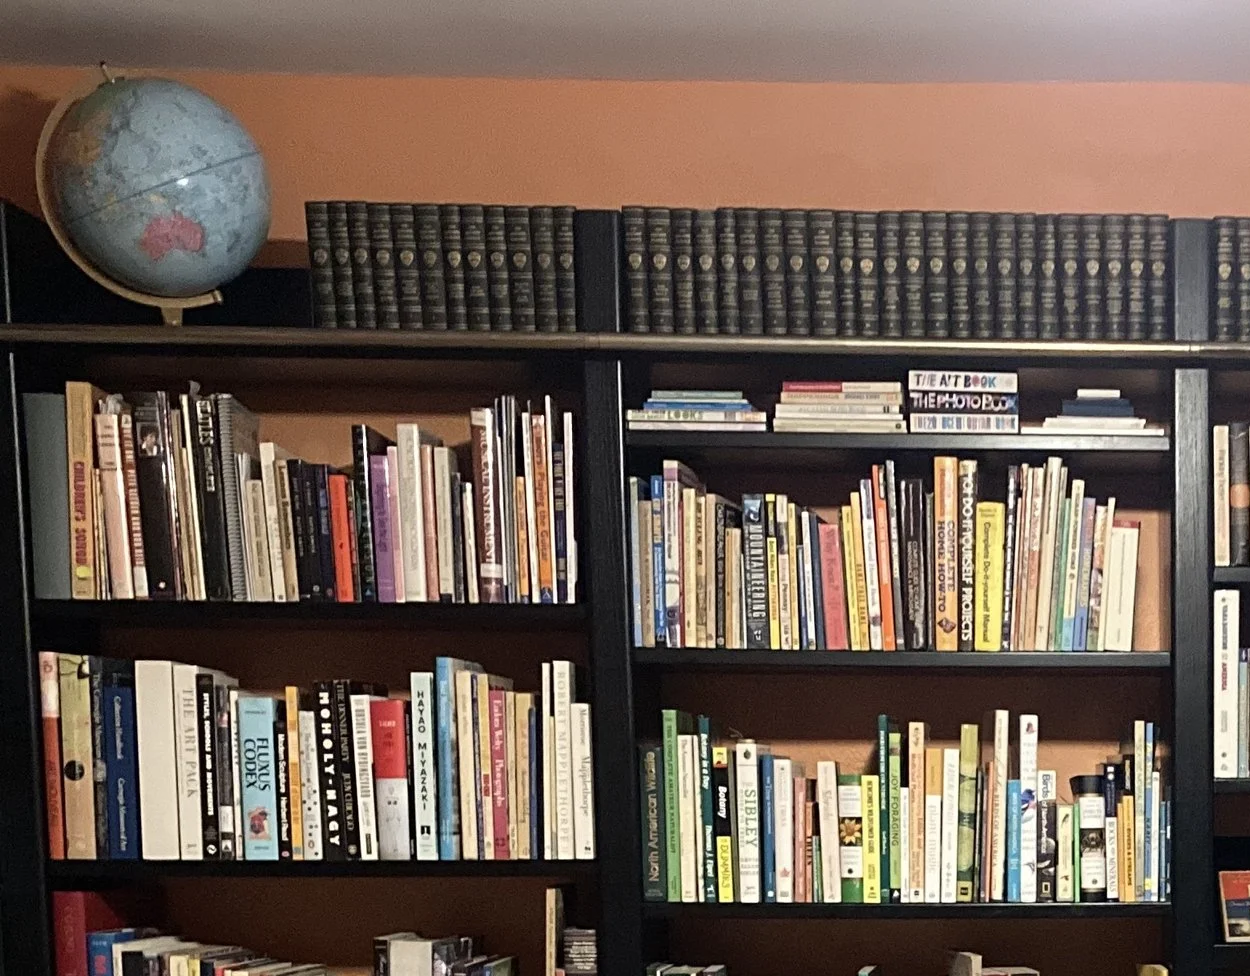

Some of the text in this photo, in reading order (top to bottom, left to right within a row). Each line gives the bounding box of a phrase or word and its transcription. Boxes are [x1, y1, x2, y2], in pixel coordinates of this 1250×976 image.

[909, 392, 937, 409] THE
[936, 392, 981, 410] PHOTO
[479, 430, 490, 483] MUSICAL
[536, 473, 550, 562] Playing the Guitar
[981, 522, 993, 559] Complete
[750, 525, 765, 619] MOUNTAINEERING
[937, 521, 946, 613] HOME HOW-TO
[946, 520, 956, 592] COMPLETE
[982, 614, 992, 644] Manual
[336, 684, 347, 701] THE
[182, 689, 198, 798] THE ART PACK
[244, 738, 258, 789] CODEX
[257, 738, 271, 791] FLUXUS
[319, 692, 340, 845] MOHOLY-NAGY
[340, 736, 351, 763] PARTY
[342, 773, 353, 792] JUDY
[716, 786, 729, 819] Botany
[344, 793, 356, 832] CHICAGO
[647, 793, 660, 848] American
[744, 789, 757, 848] SIBLEY
[891, 774, 901, 847] JOY FORAGING
[647, 853, 661, 883] North
